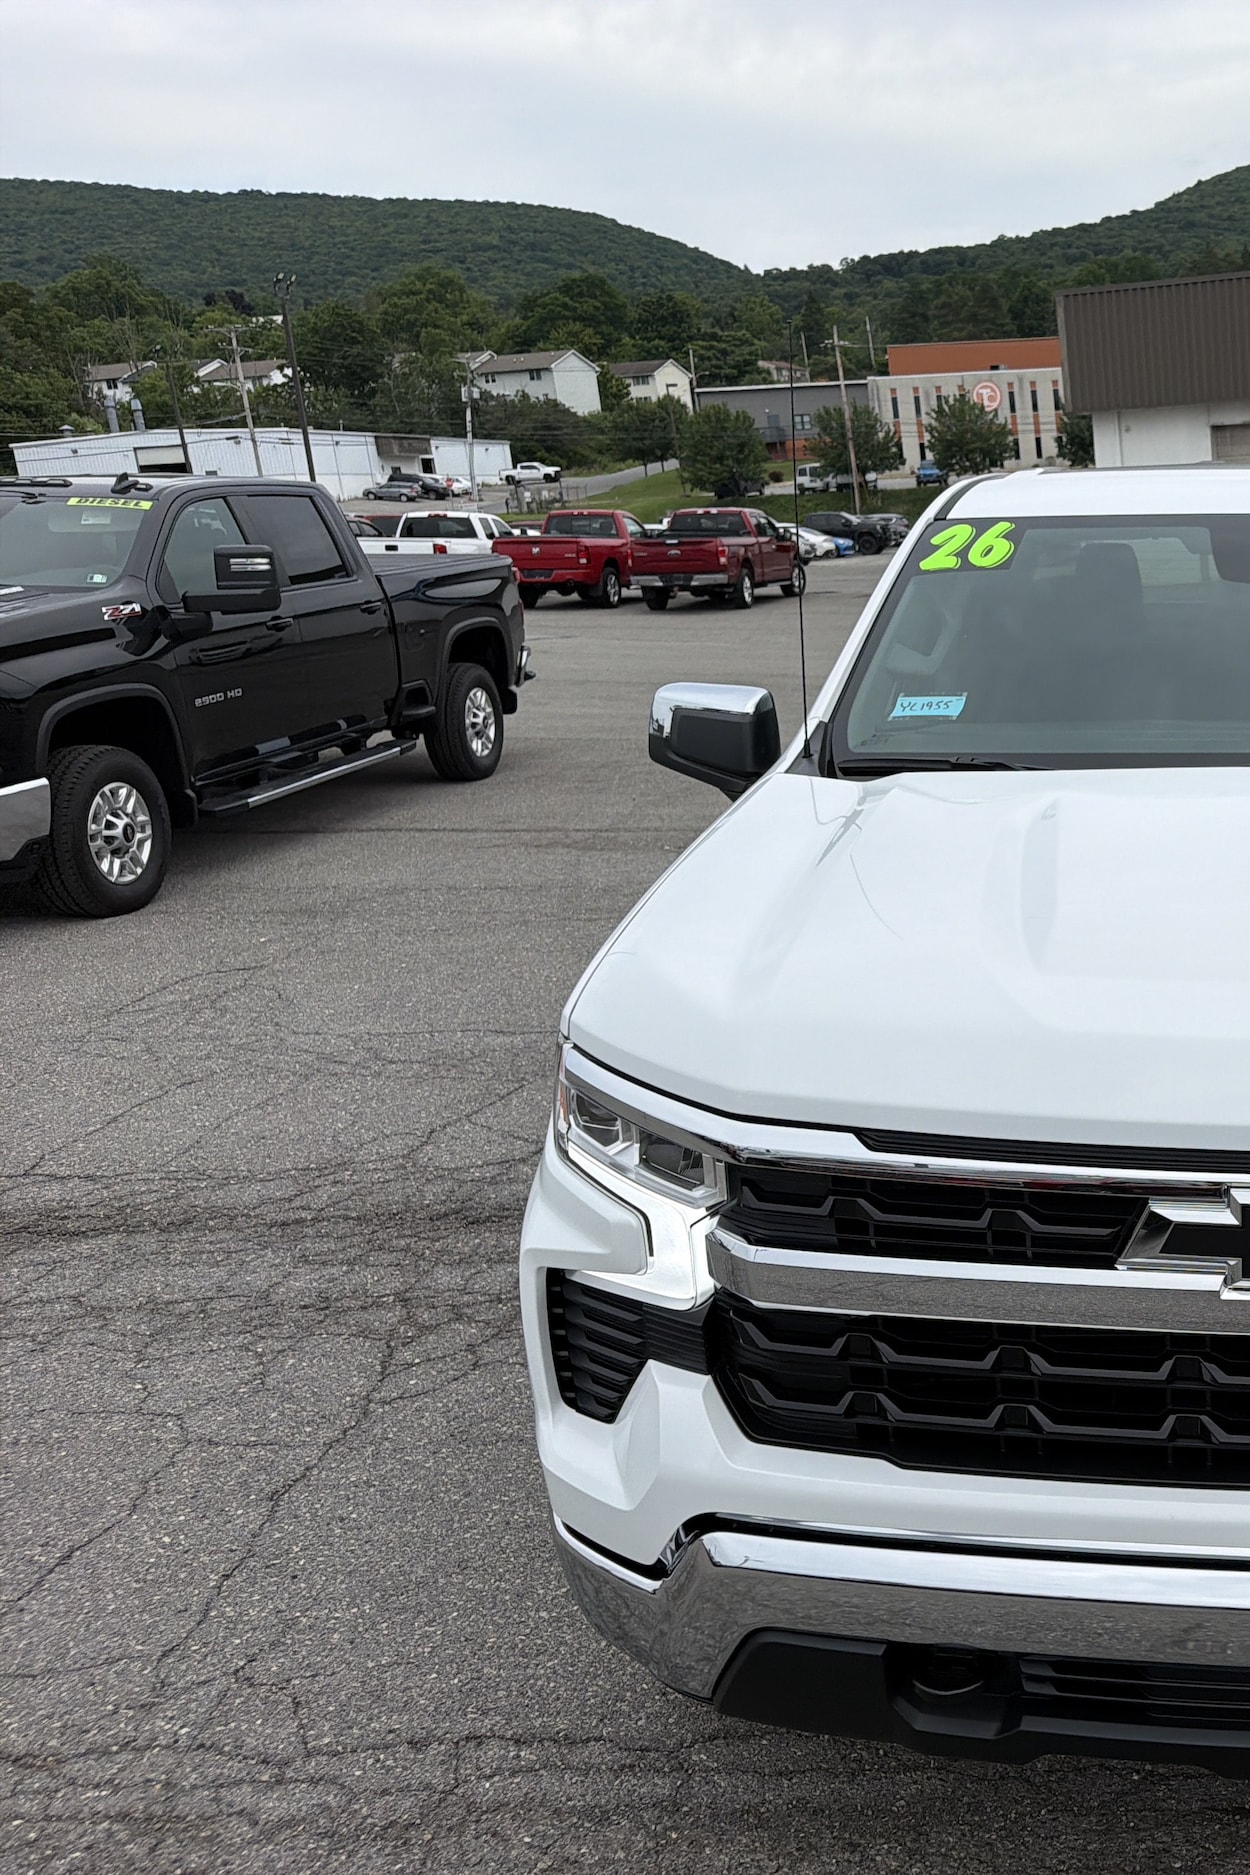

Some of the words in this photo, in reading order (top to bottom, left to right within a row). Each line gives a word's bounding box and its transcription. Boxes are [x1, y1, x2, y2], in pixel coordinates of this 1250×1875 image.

[76, 498, 144, 507] DIESEL
[919, 521, 1016, 571] 26
[102, 603, 141, 620] Z71
[195, 692, 224, 707] 2500
[227, 688, 242, 699] HD
